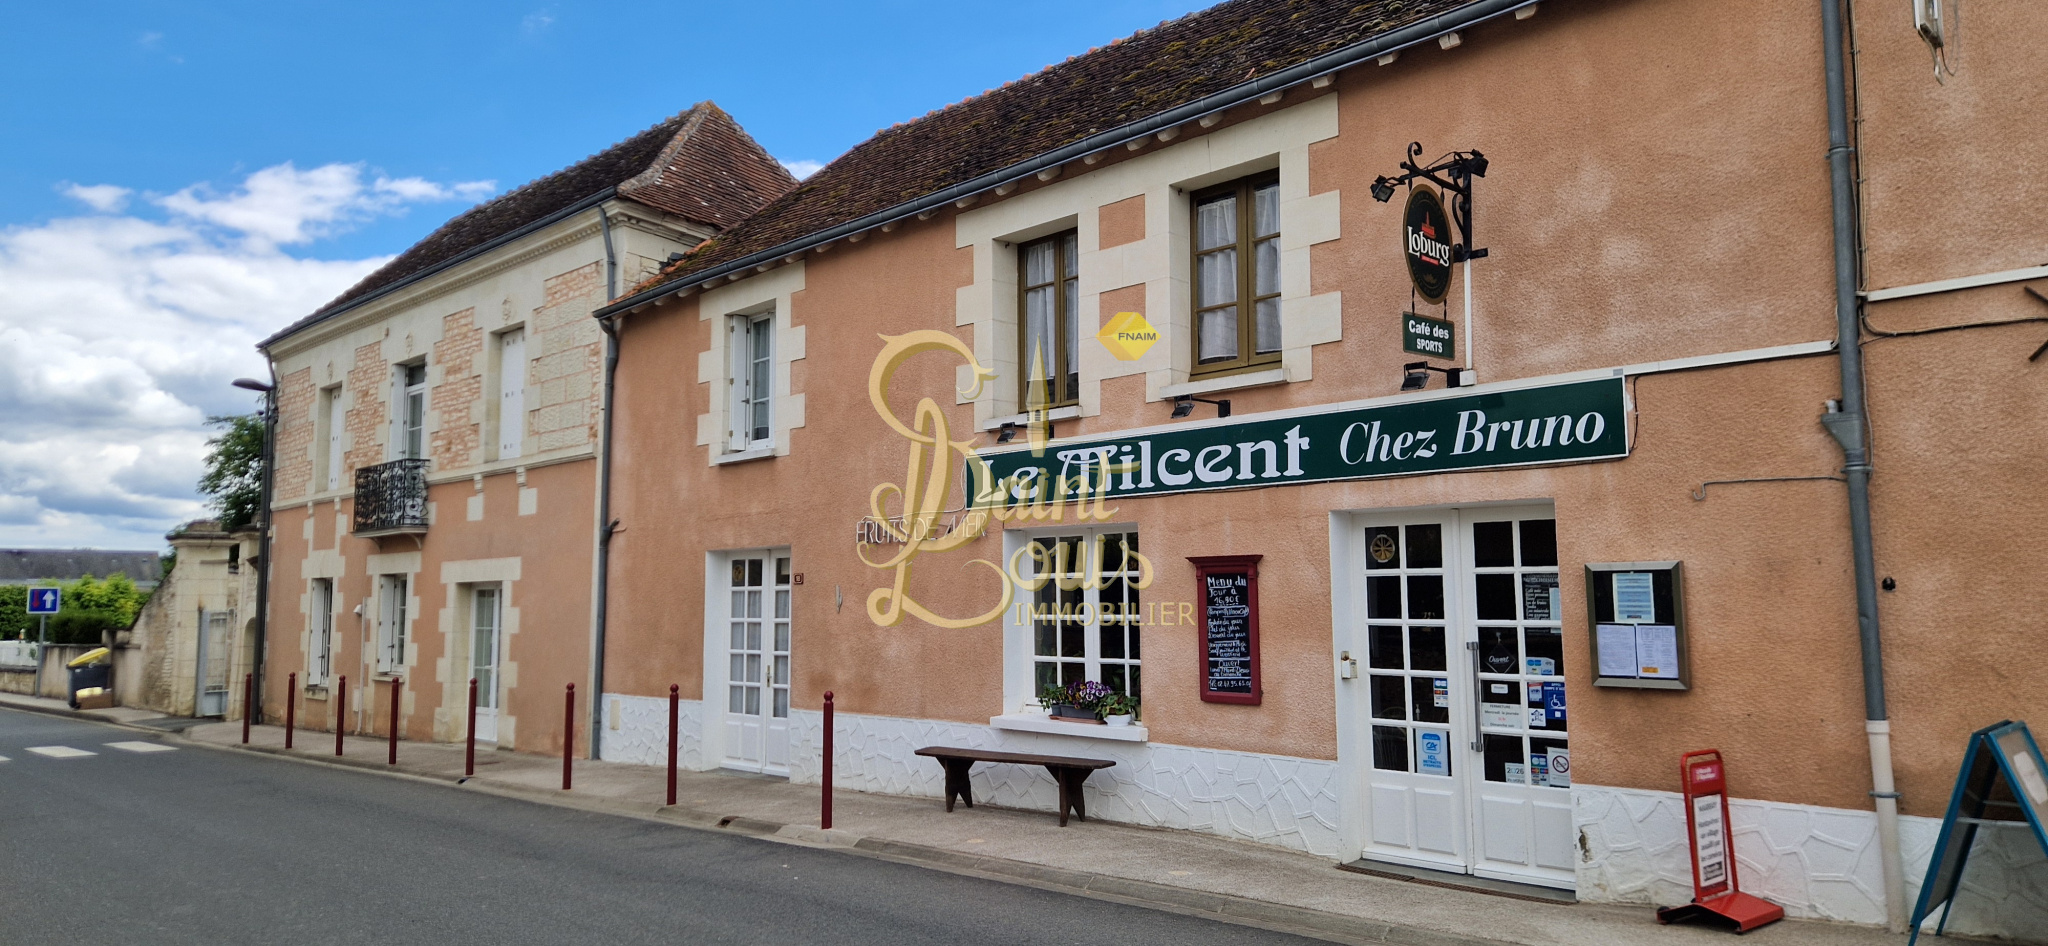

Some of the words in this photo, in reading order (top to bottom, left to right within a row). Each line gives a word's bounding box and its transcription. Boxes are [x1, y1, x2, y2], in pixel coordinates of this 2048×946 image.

[1407, 225, 1450, 267] Loburg
[1408, 319, 1431, 336] Café
[1432, 324, 1449, 340] des
[1416, 338, 1443, 353] SPORTS
[974, 459, 1040, 503] Le
[1056, 425, 1311, 496] Milcent
[1339, 420, 1437, 467] Chez
[1451, 410, 1605, 458] Bruno
[856, 519, 908, 544] FRUITS
[913, 516, 937, 542] DE
[943, 510, 988, 538] MER
[1207, 576, 1233, 587] Menu
[1235, 575, 1247, 587] du
[1489, 655, 1510, 664] Ouvert
